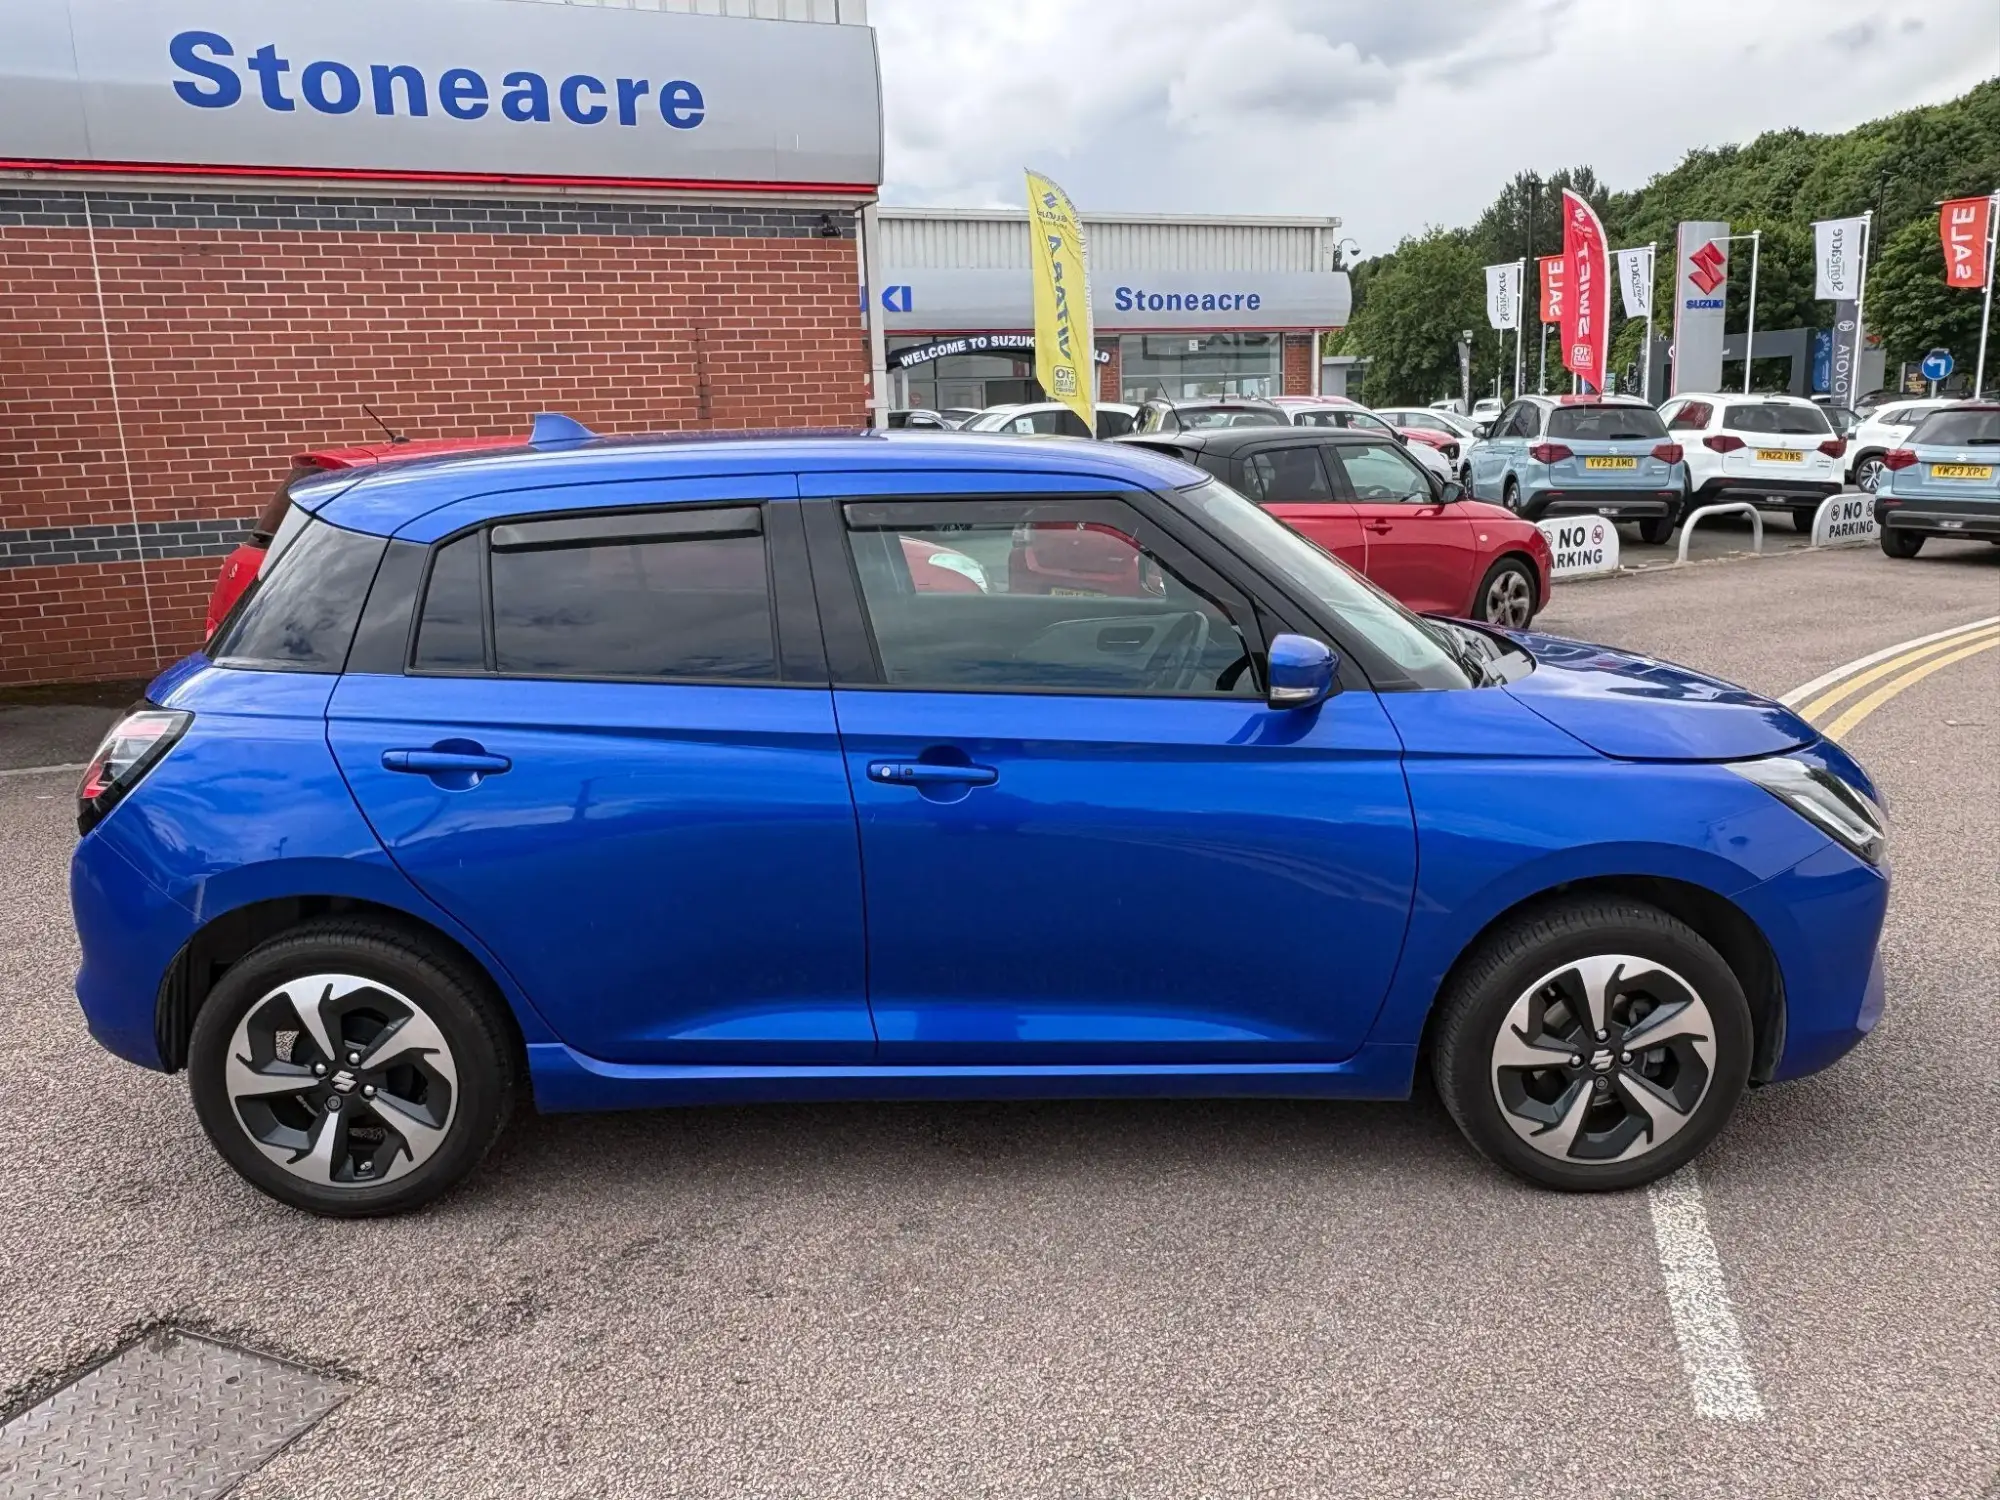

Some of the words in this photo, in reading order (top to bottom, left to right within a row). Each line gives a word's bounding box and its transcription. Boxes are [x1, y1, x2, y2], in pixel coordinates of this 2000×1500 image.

[169, 30, 705, 130] Stoneacre
[1115, 286, 1261, 311] Stoneacre
[1686, 299, 1724, 309] SUZUKI
[900, 341, 966, 367] WELCOME
[969, 337, 987, 349] TO
[990, 335, 1035, 348] SUZUK
[1590, 457, 1613, 467] YV23
[1966, 466, 1988, 477] XPC
[1844, 502, 1861, 520] NO
[1559, 527, 1586, 549] NO
[1829, 520, 1874, 539] PARKING
